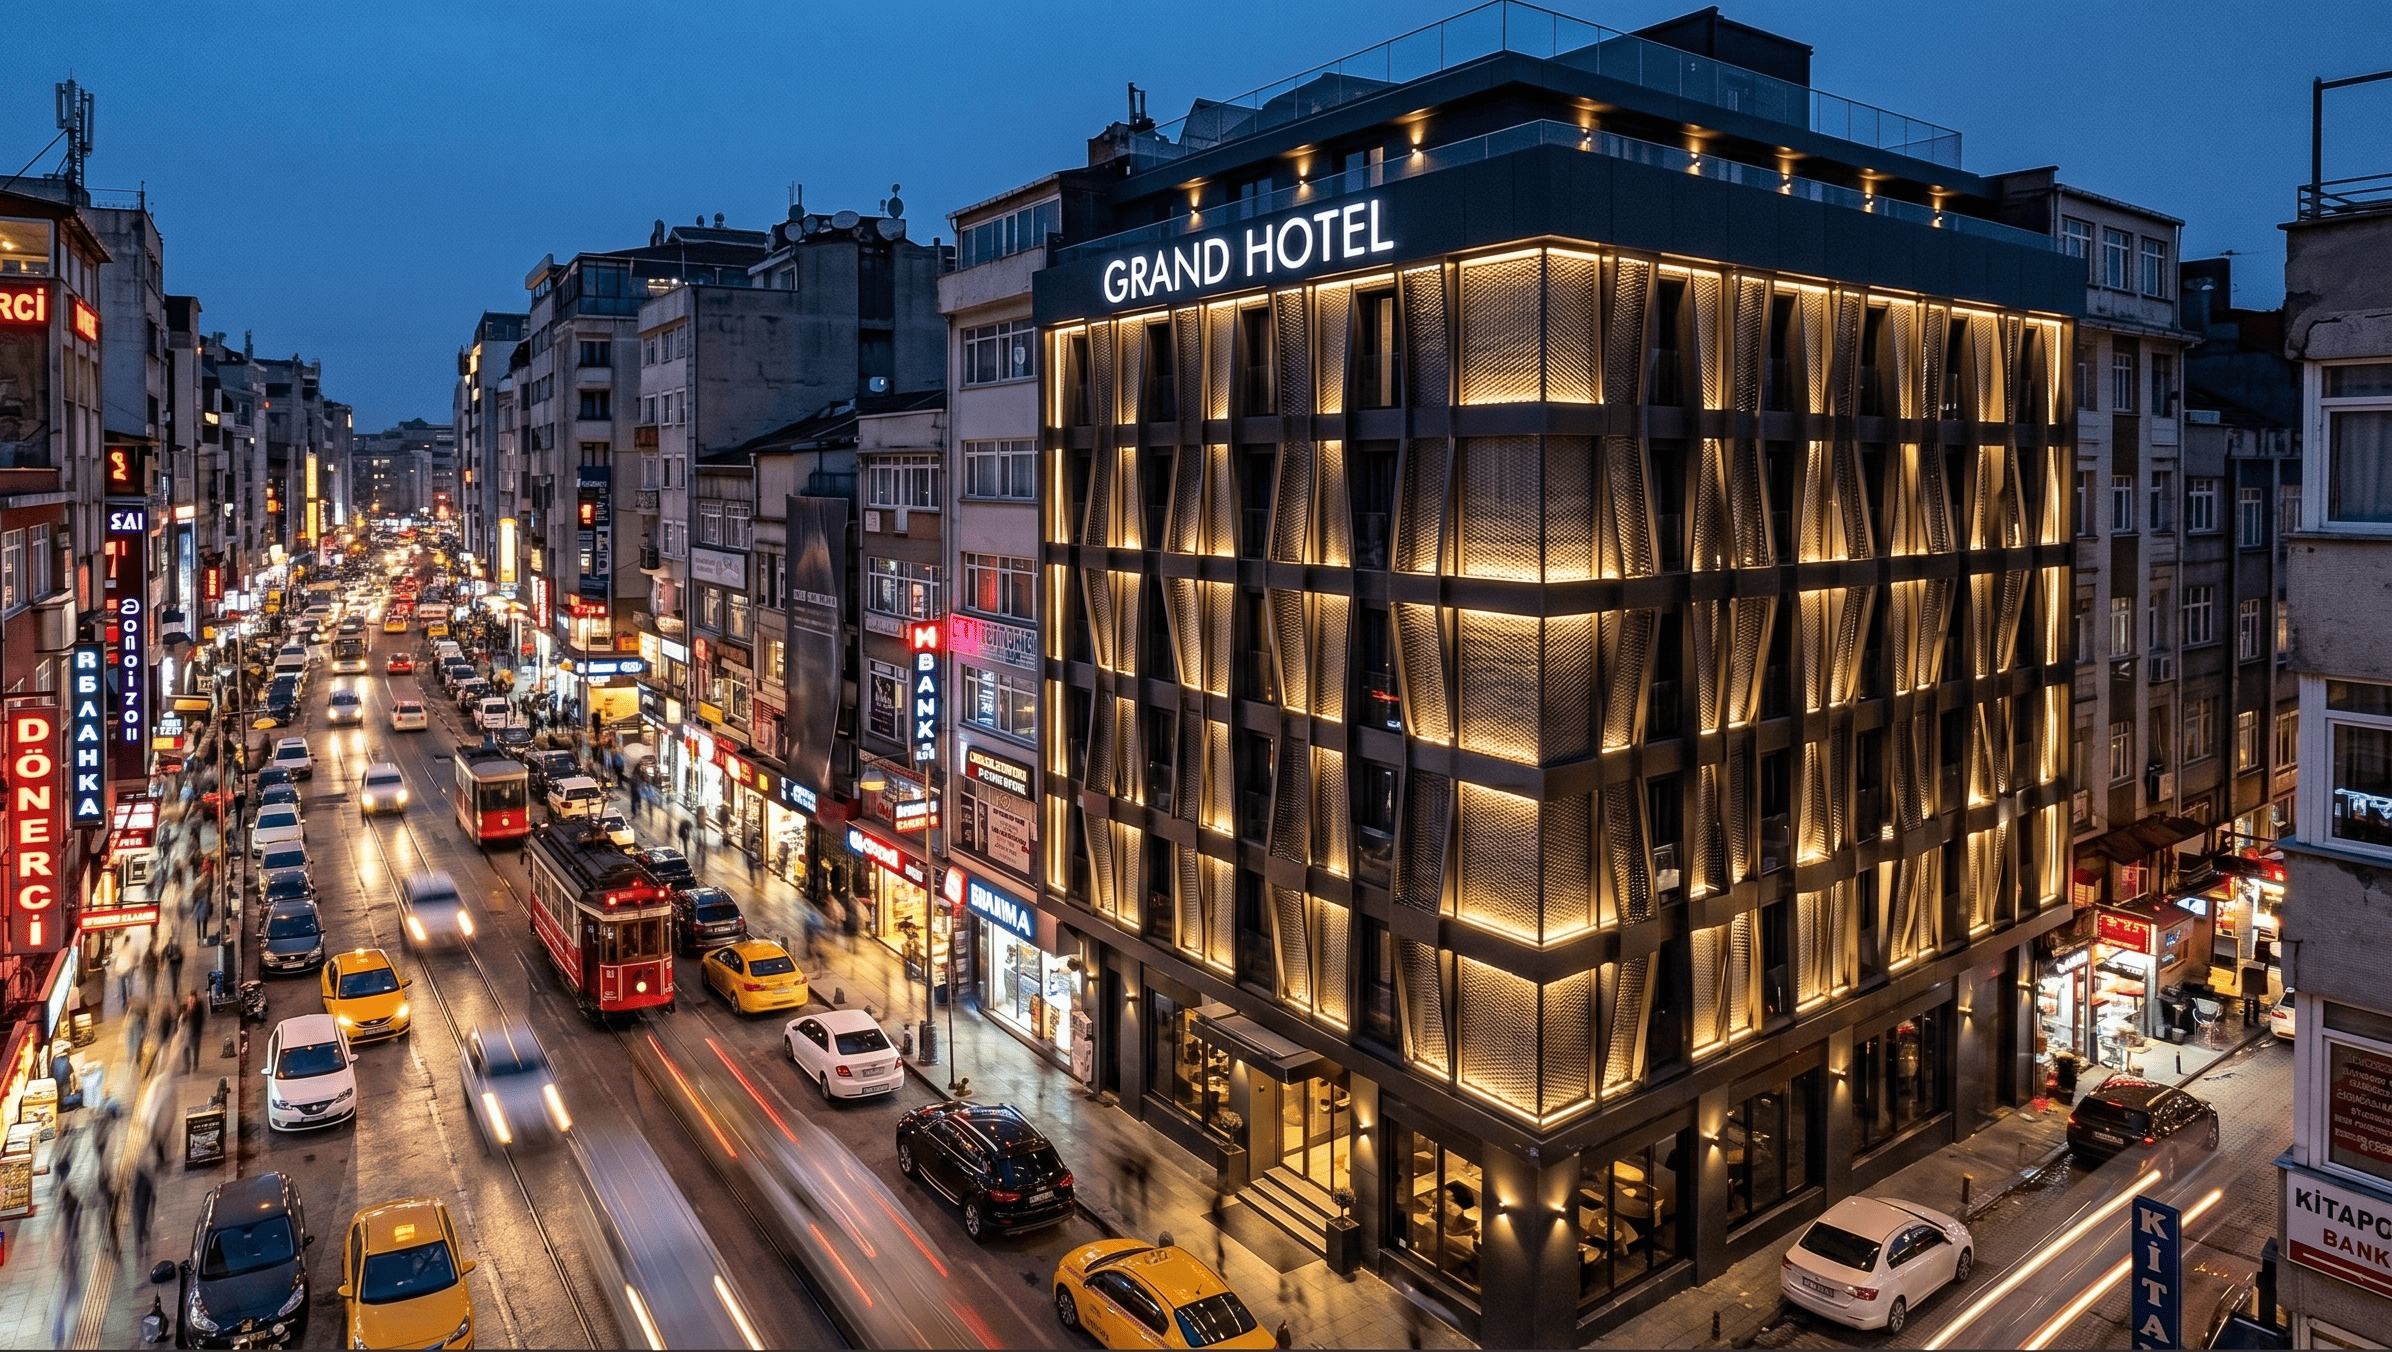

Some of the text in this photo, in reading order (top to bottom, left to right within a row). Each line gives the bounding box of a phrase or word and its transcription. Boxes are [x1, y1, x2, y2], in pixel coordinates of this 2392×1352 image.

[1104, 199, 1395, 303] GRAND HOTEL
[15, 717, 52, 946] DÖNERCİ
[2138, 1207, 2171, 1350] KİTA
[2323, 1227, 2392, 1269] BANK
